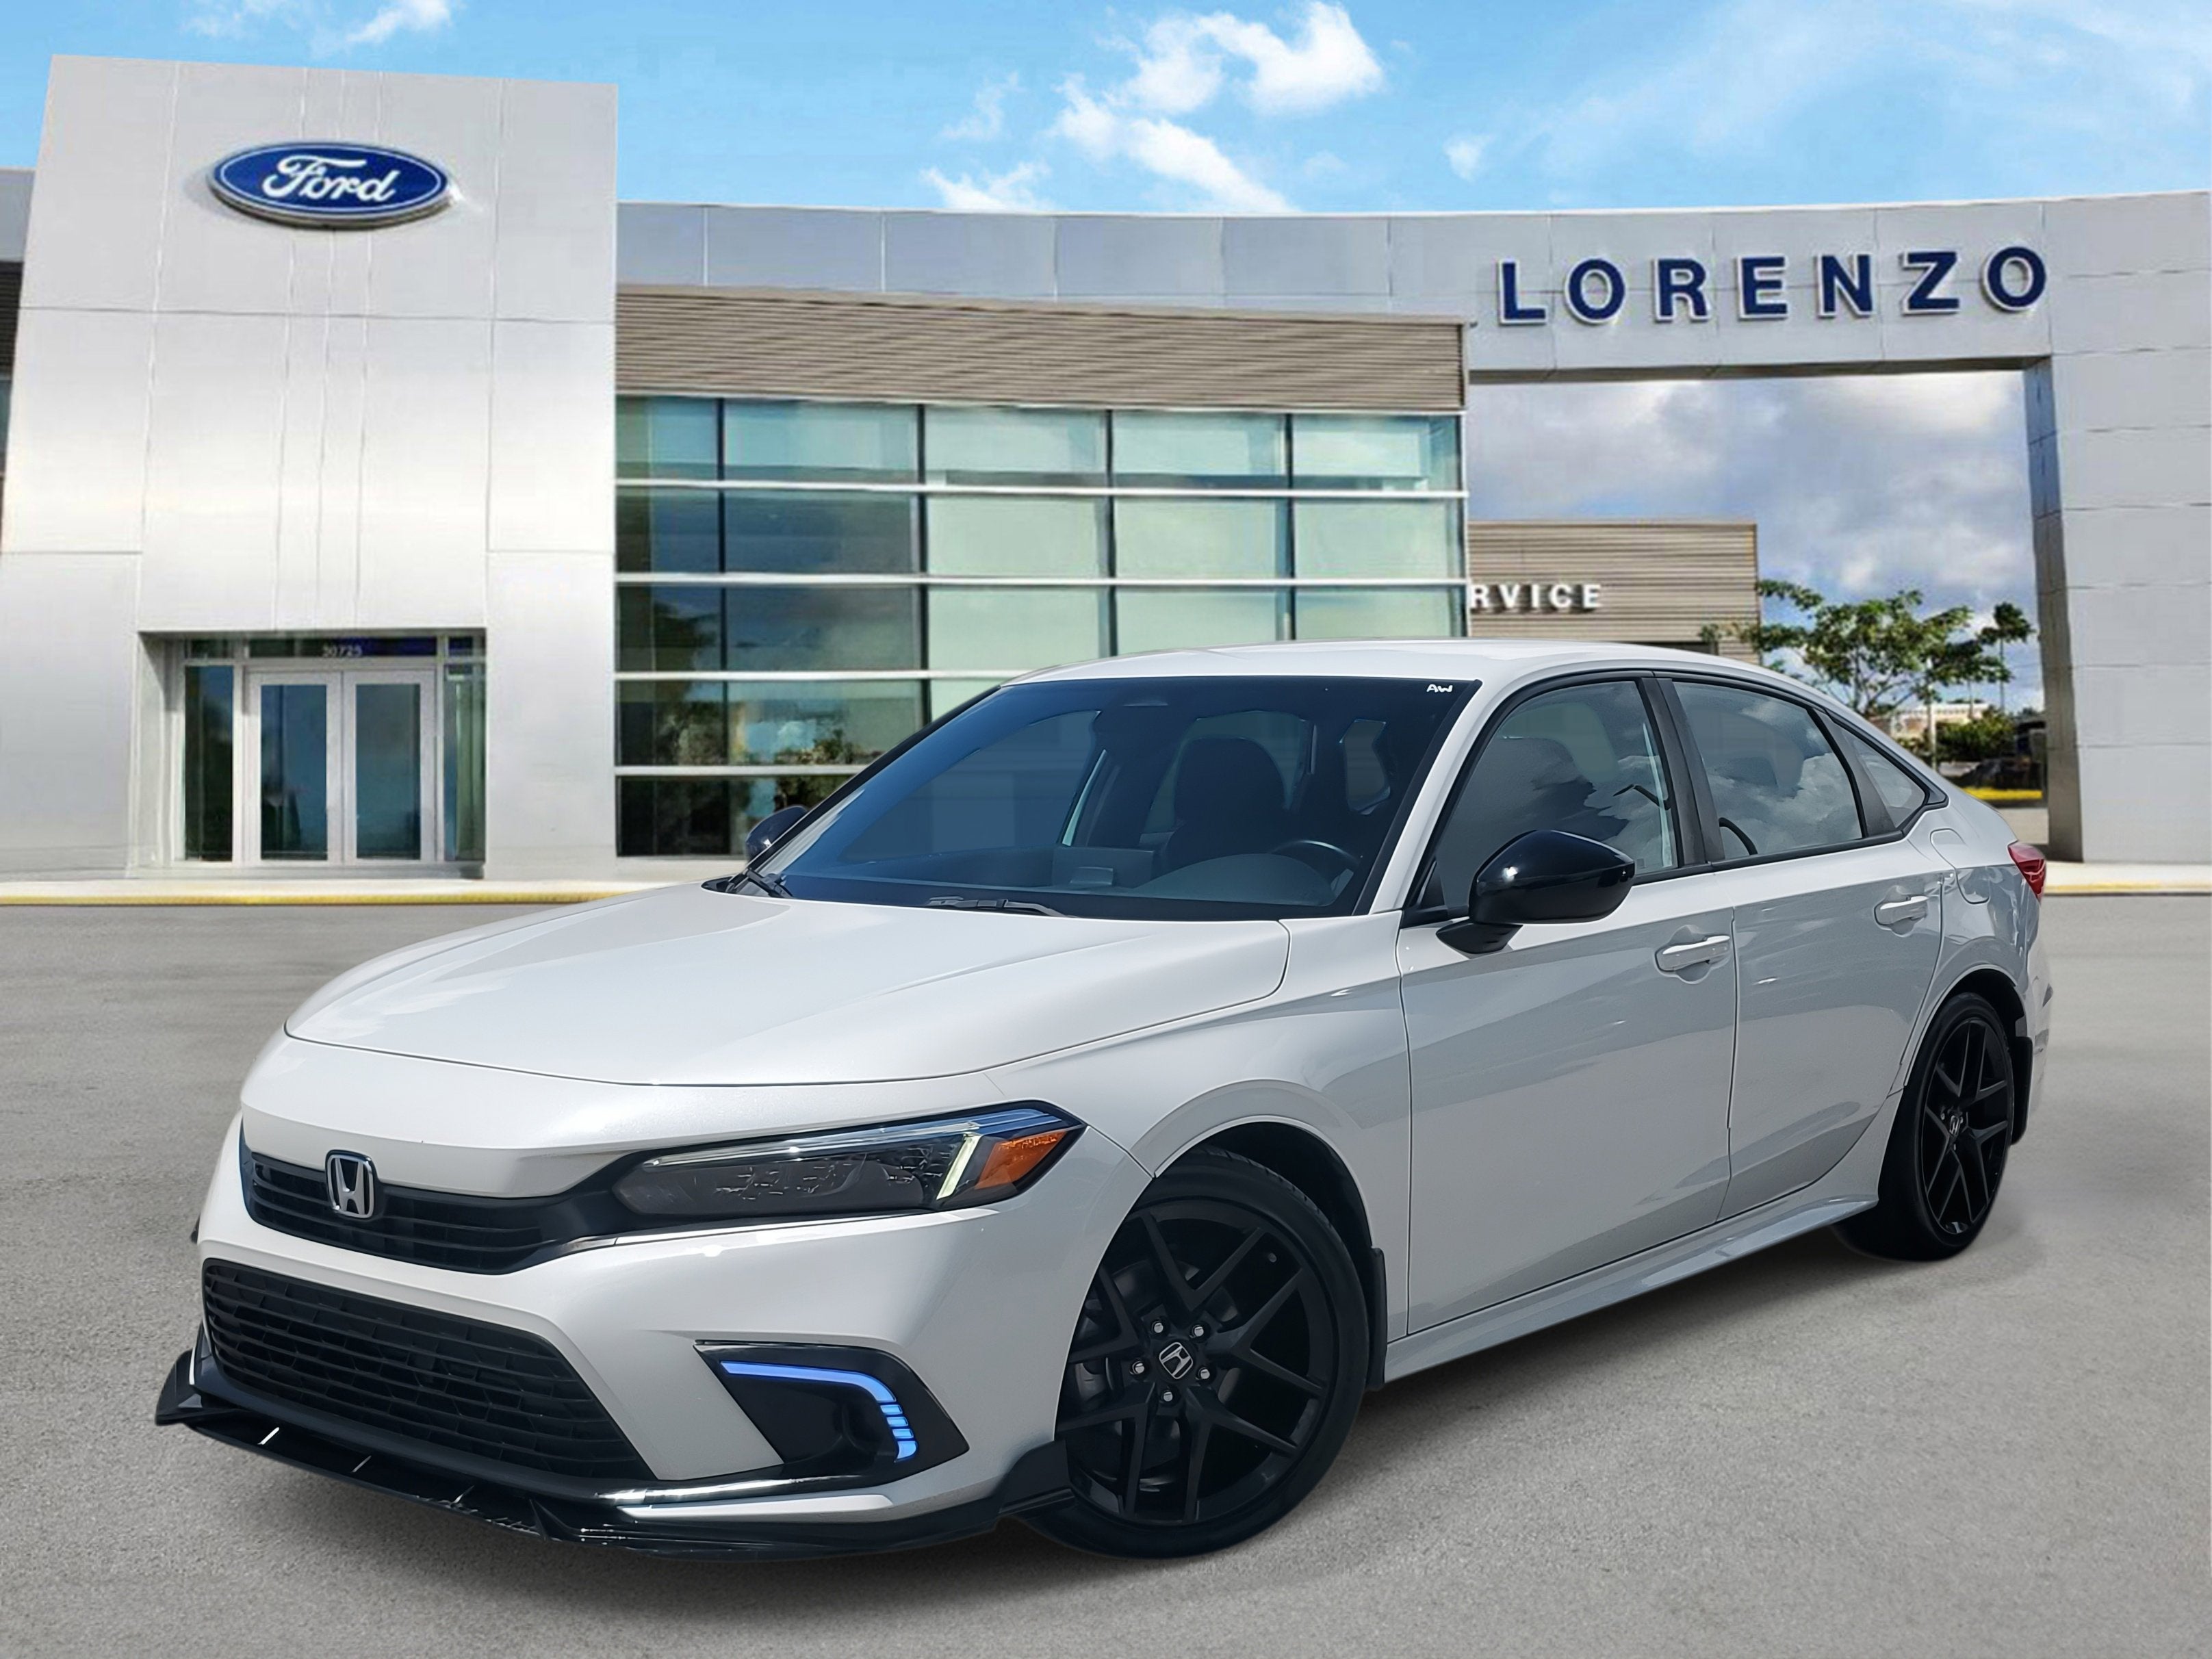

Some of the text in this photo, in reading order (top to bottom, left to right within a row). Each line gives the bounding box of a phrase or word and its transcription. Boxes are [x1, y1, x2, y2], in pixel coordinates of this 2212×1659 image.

[262, 154, 401, 202] Ford
[1496, 245, 2048, 326] LORENZO
[1469, 583, 1603, 608] RVICE
